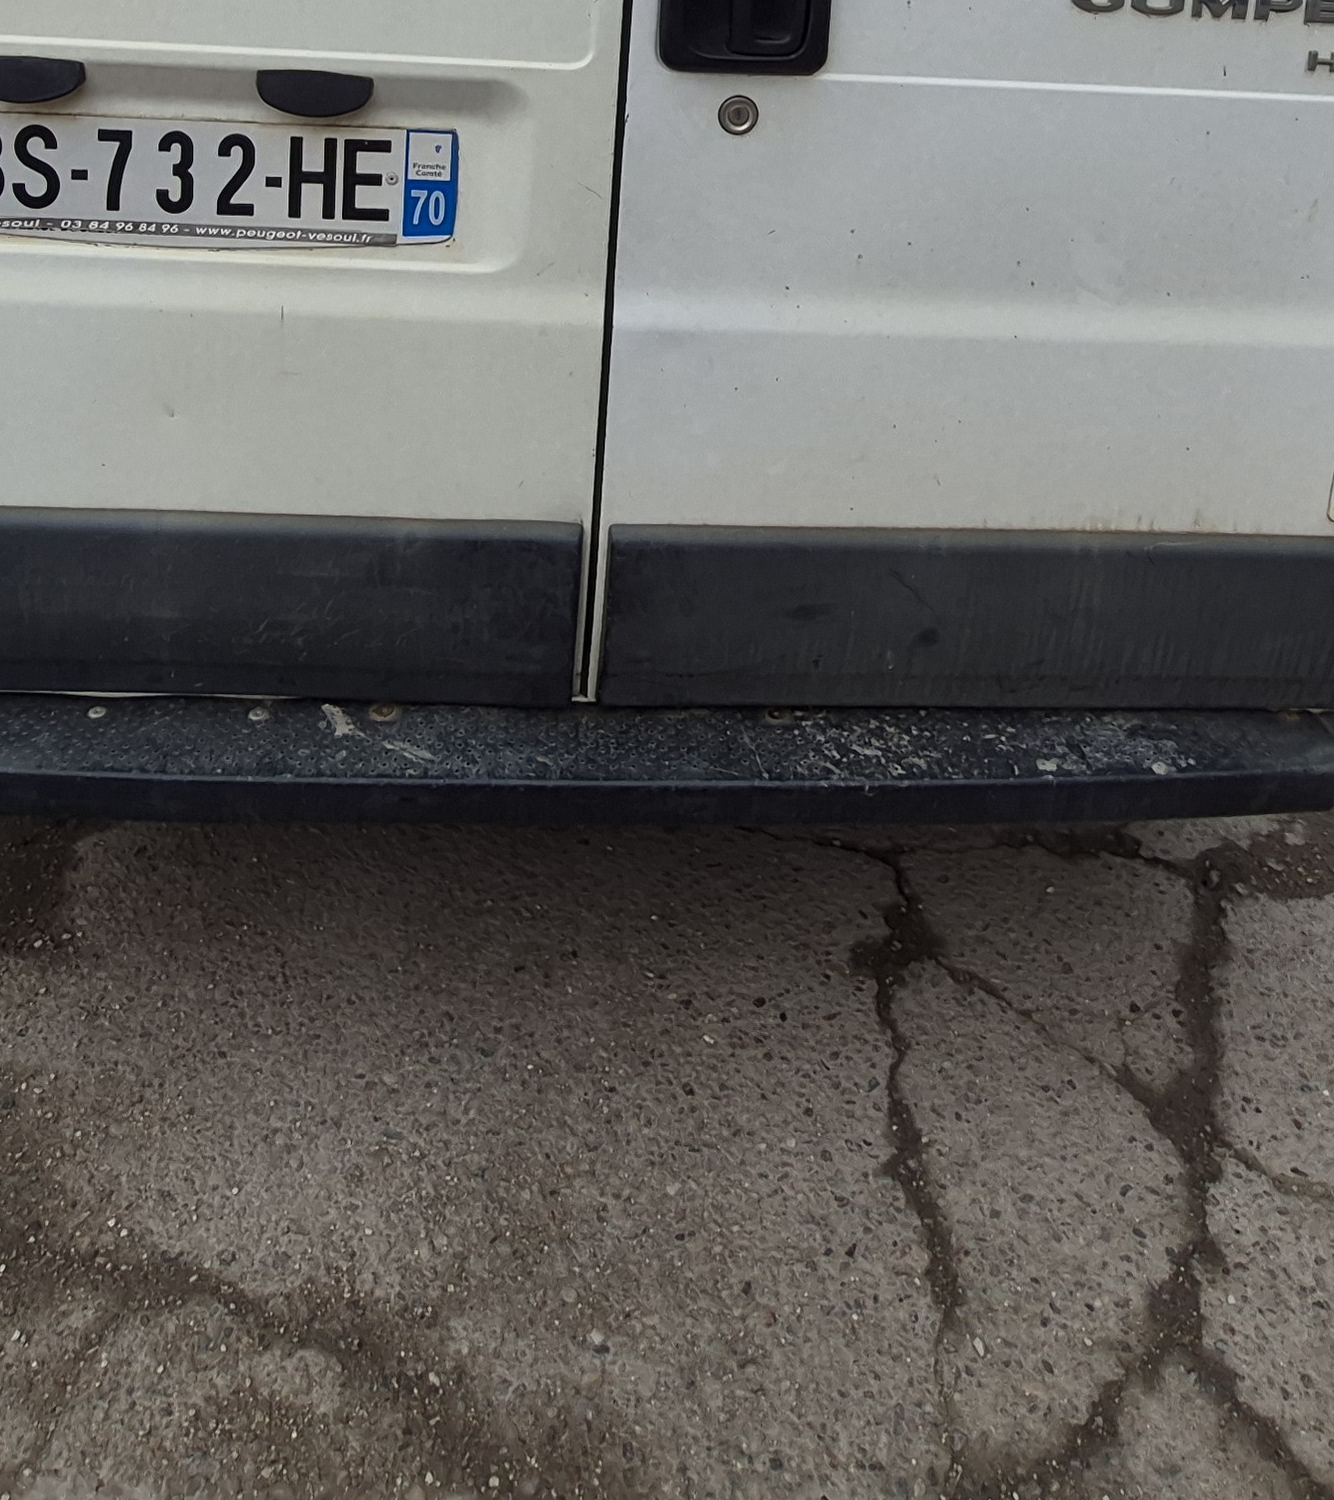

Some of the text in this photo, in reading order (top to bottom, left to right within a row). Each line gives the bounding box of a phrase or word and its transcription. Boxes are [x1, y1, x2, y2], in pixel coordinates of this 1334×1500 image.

[412, 162, 447, 171] Franche
[415, 170, 442, 178] Comté
[410, 189, 446, 226] 70
[60, 219, 81, 230] 03
[88, 220, 110, 231] 84
[115, 221, 133, 232] 96
[138, 222, 157, 233] 84
[161, 223, 179, 234] 96
[195, 226, 372, 244] www.peugeot-vesoul.fr
